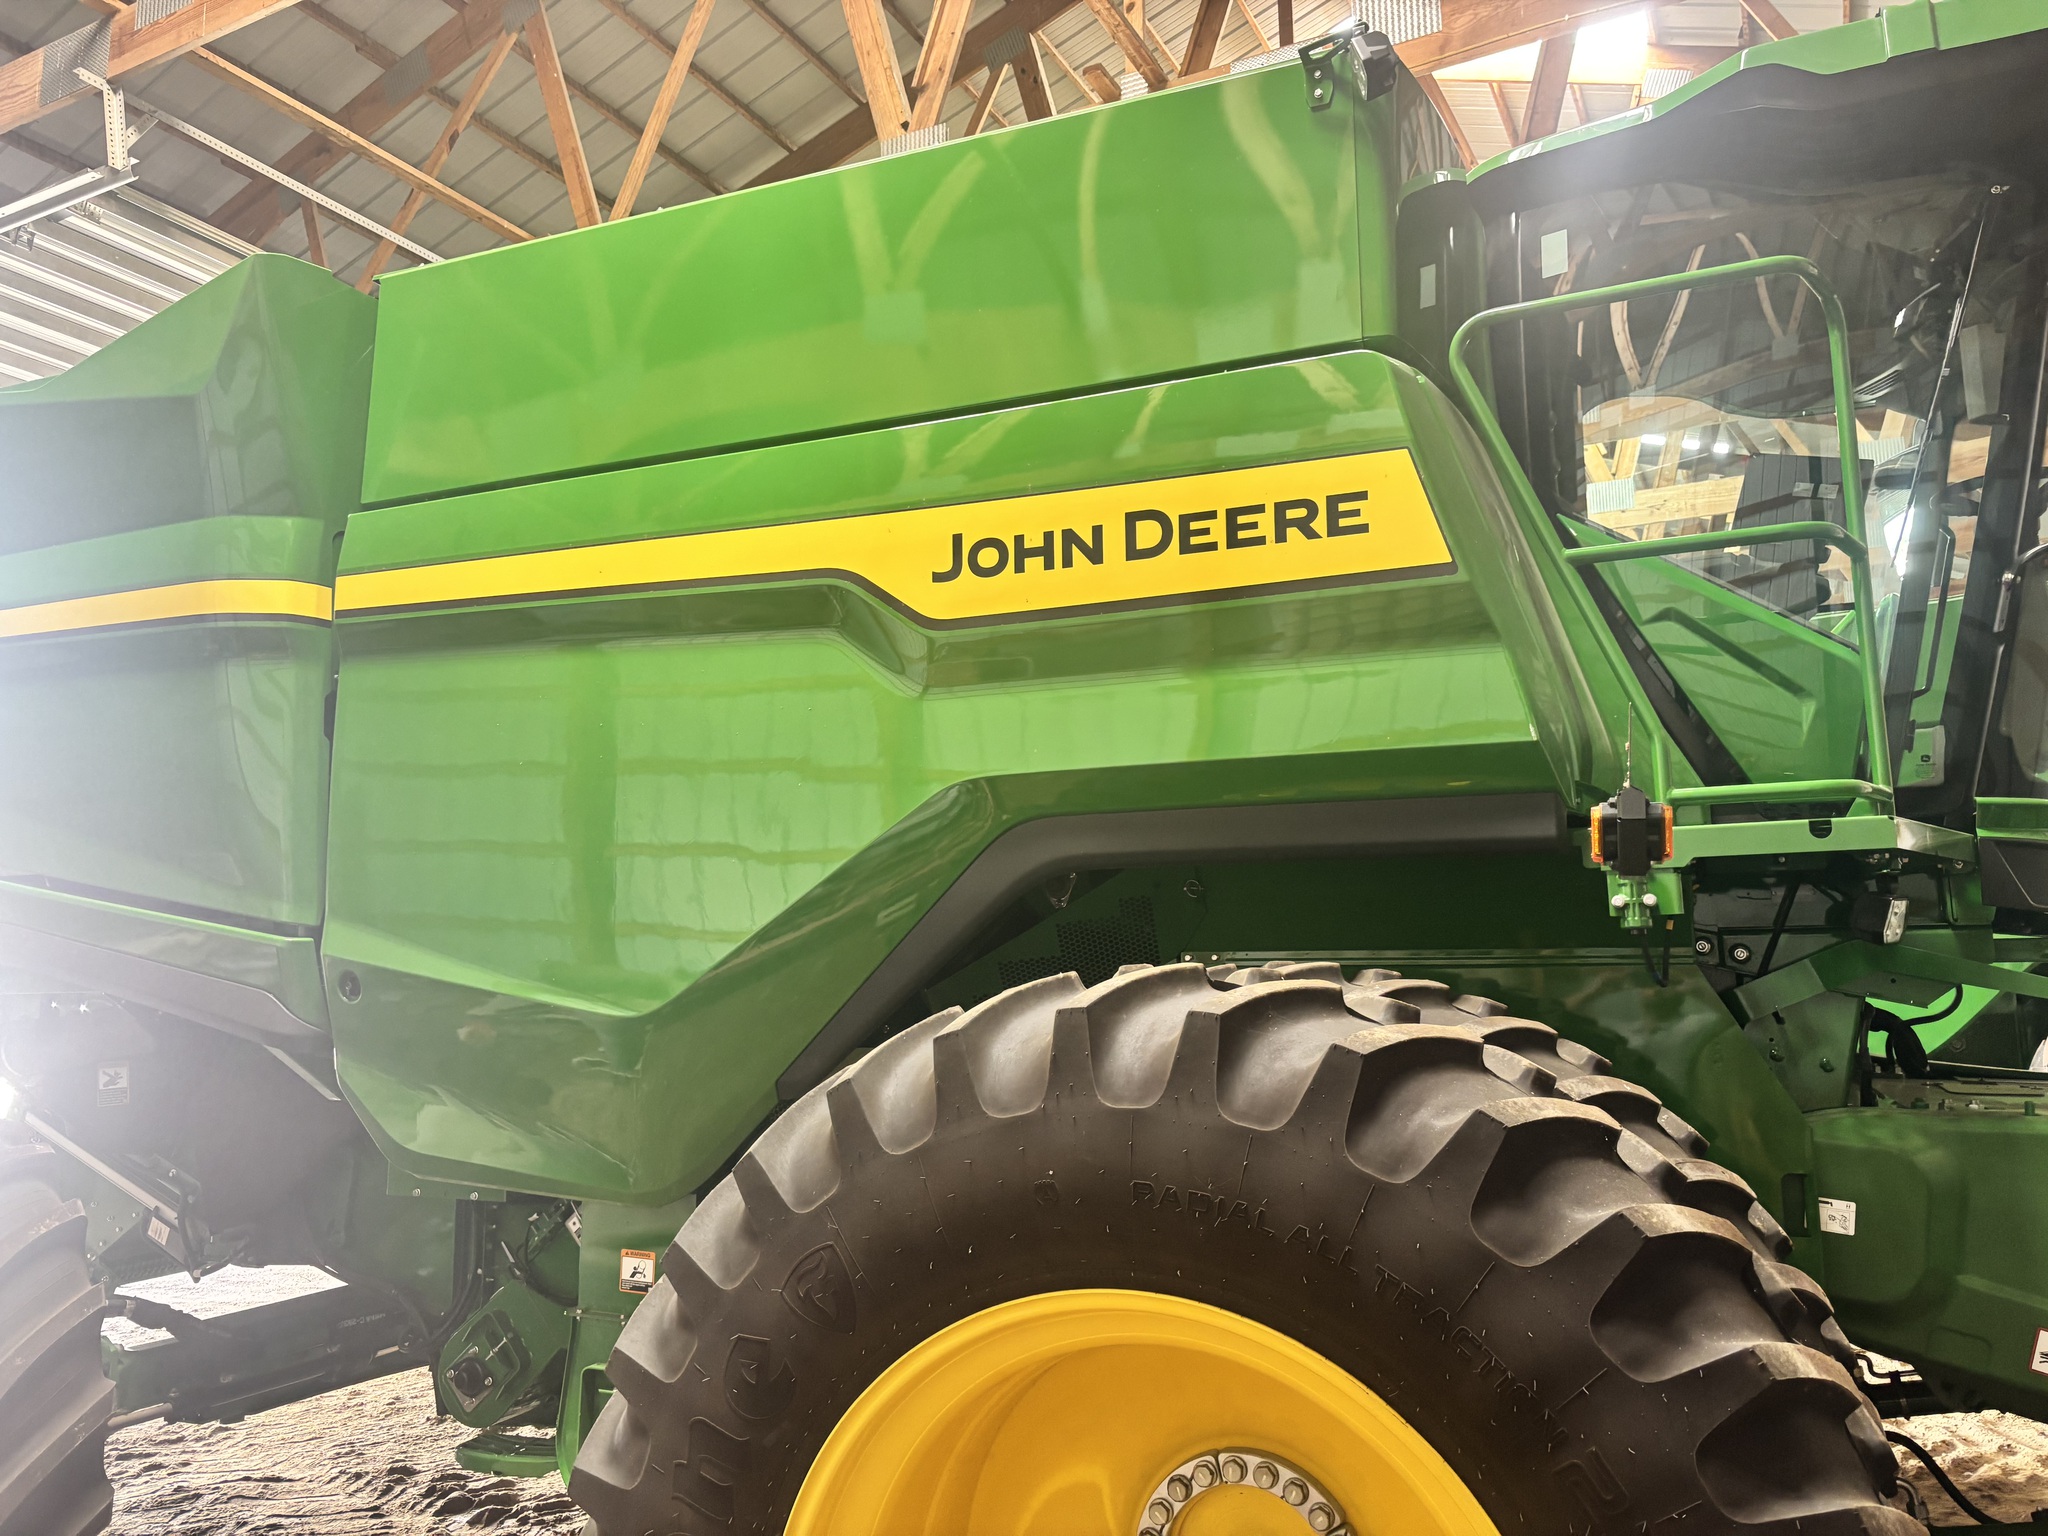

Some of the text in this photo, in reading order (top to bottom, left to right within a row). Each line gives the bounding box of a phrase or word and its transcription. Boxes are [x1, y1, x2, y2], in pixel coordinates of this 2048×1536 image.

[932, 490, 1369, 583] JOHN DEERE
[1130, 1180, 1275, 1235] RADIAL
[1283, 1224, 1358, 1275] ALL
